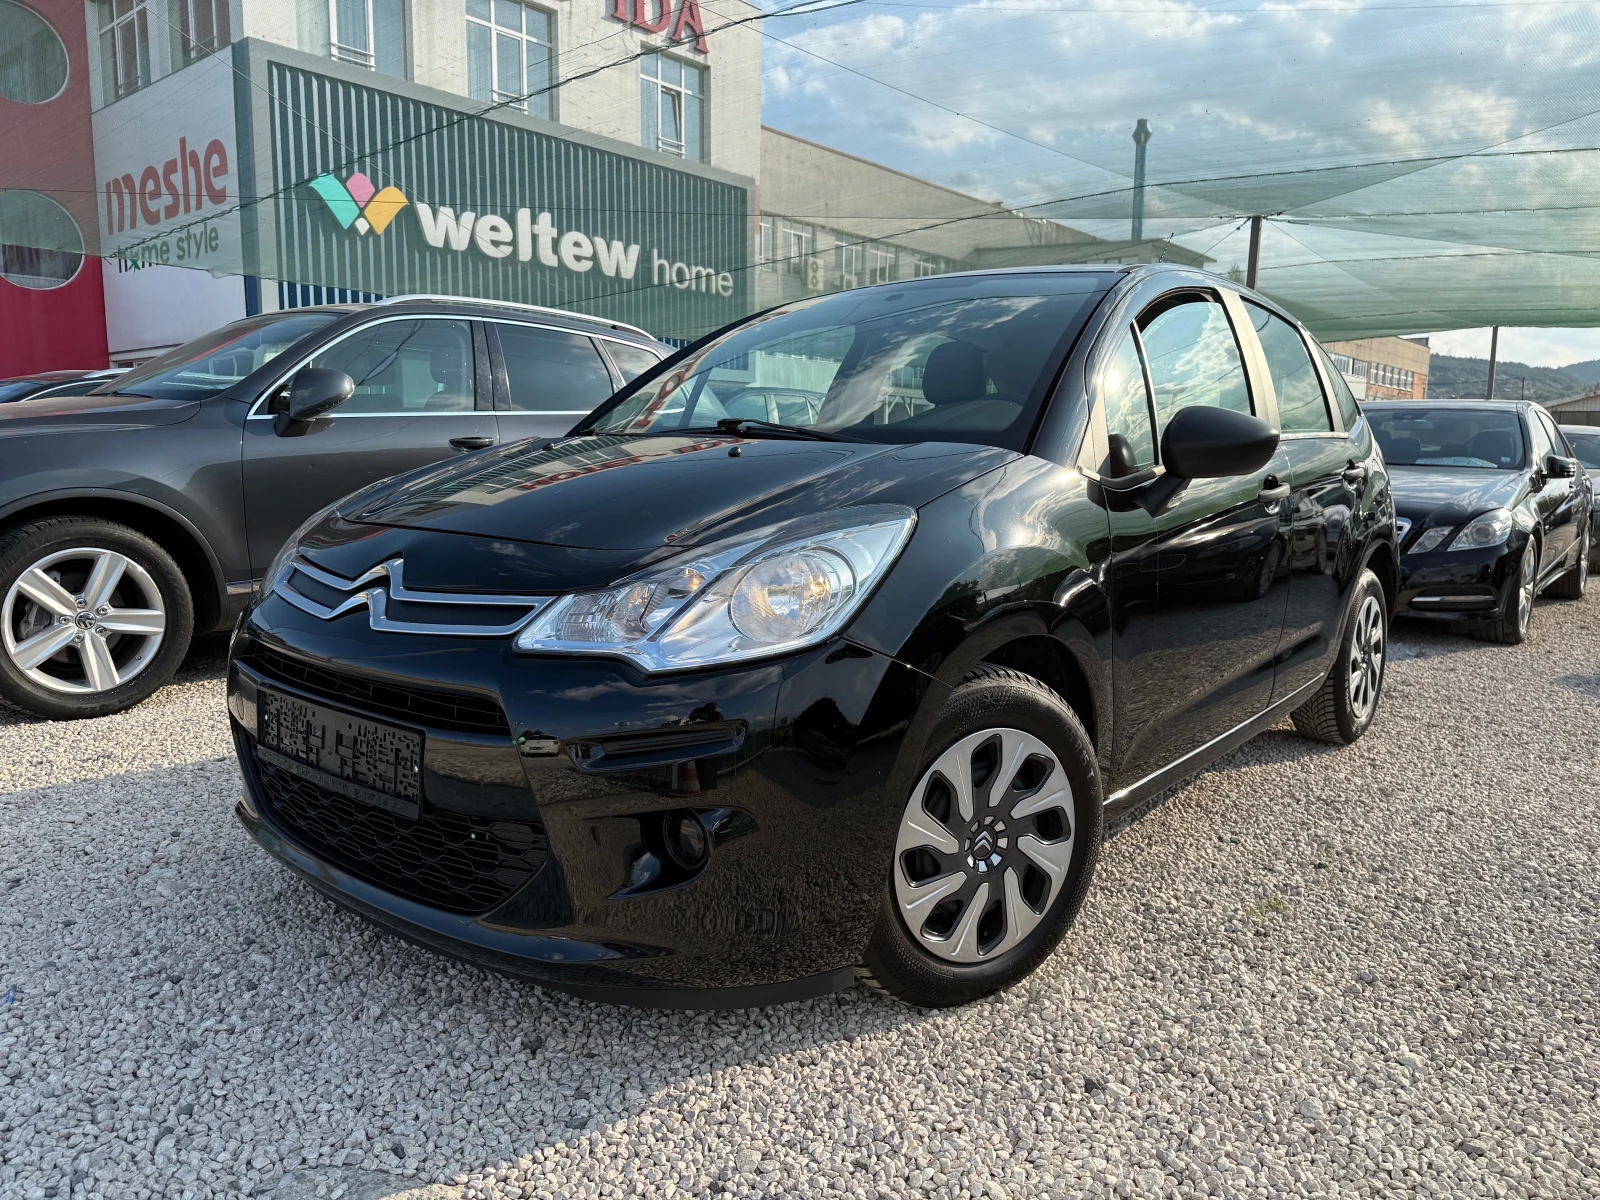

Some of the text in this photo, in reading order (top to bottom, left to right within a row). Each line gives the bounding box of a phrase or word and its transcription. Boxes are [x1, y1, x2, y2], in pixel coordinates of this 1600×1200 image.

[105, 136, 229, 236] meshe
[176, 222, 219, 261] style
[414, 201, 734, 297] weltew home
